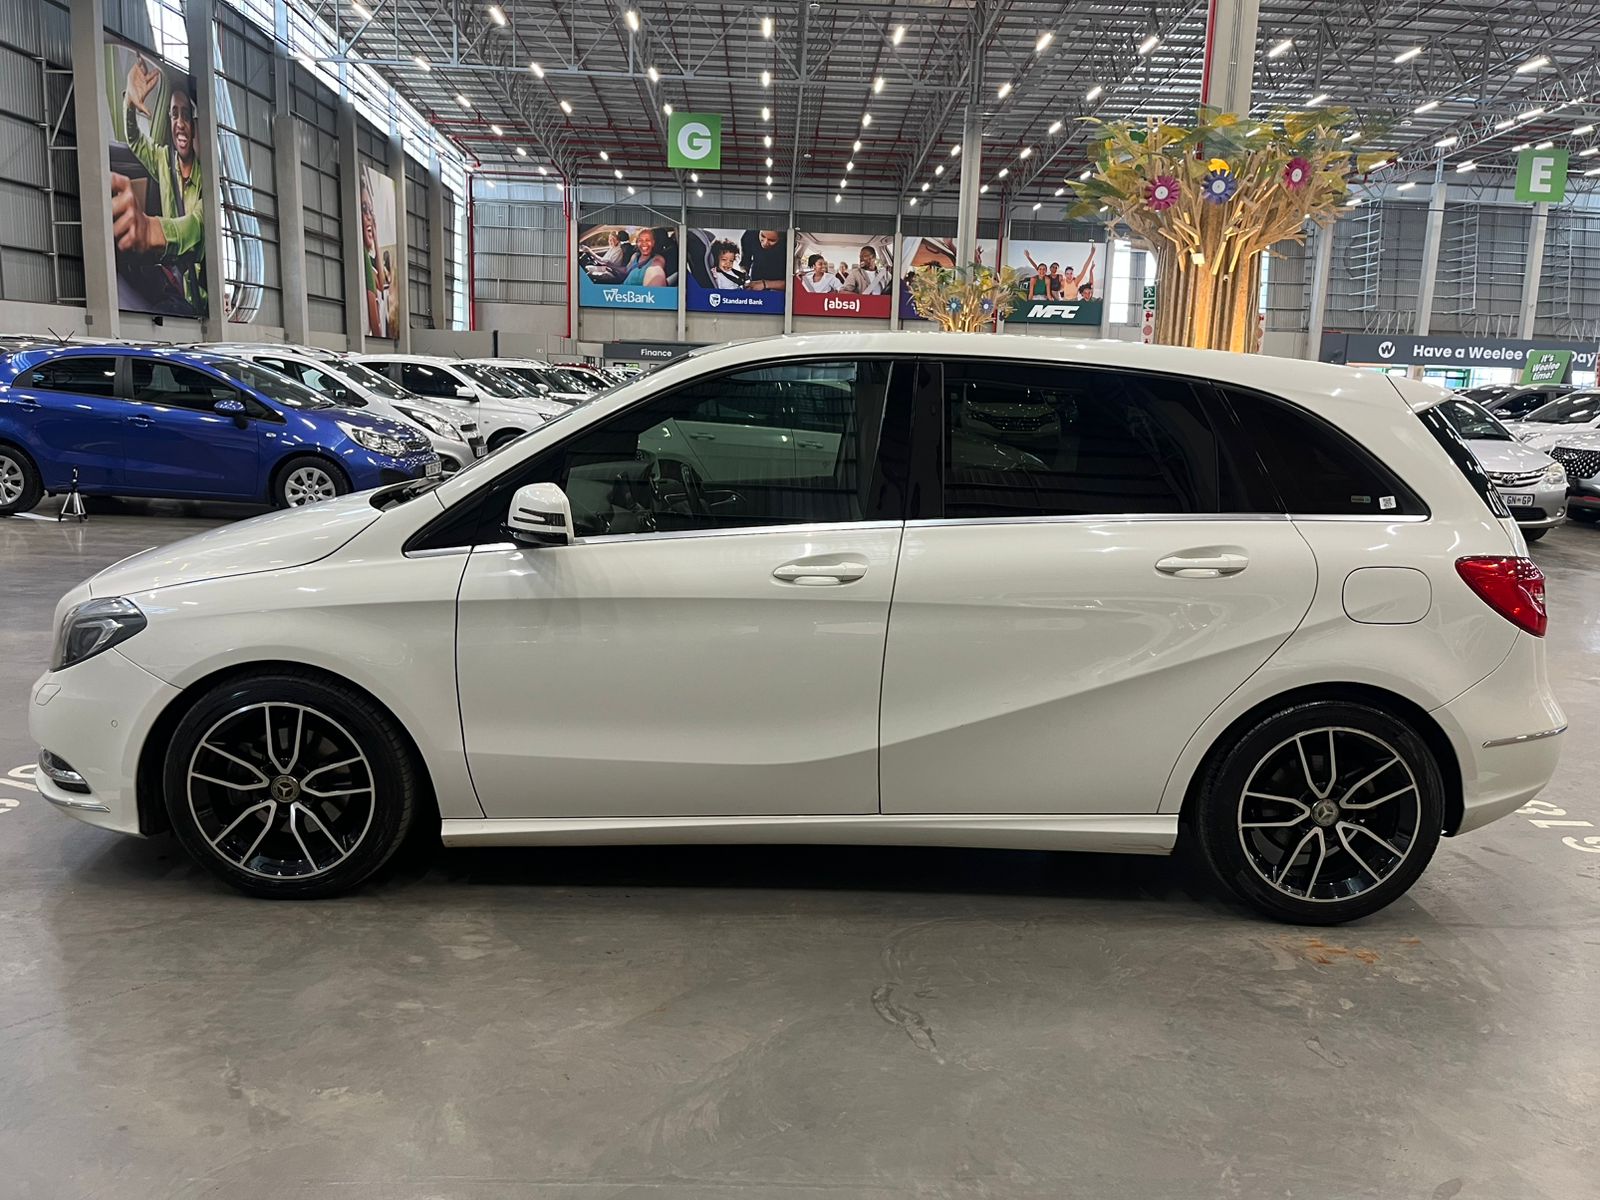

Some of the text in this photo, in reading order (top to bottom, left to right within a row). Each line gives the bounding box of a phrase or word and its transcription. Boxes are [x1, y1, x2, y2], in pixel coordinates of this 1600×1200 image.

[677, 121, 712, 160] G
[1529, 156, 1554, 193] E
[603, 288, 655, 304] WesBank
[722, 297, 763, 306] Standard Bank
[1027, 304, 1079, 319] MFC
[640, 348, 672, 357] Finance
[1413, 344, 1452, 358] Have
[1455, 348, 1465, 358] a
[1469, 346, 1523, 360] Weelee
[1541, 354, 1554, 362] It's
[1532, 362, 1560, 373] Weelee
[1532, 370, 1555, 380] time!
